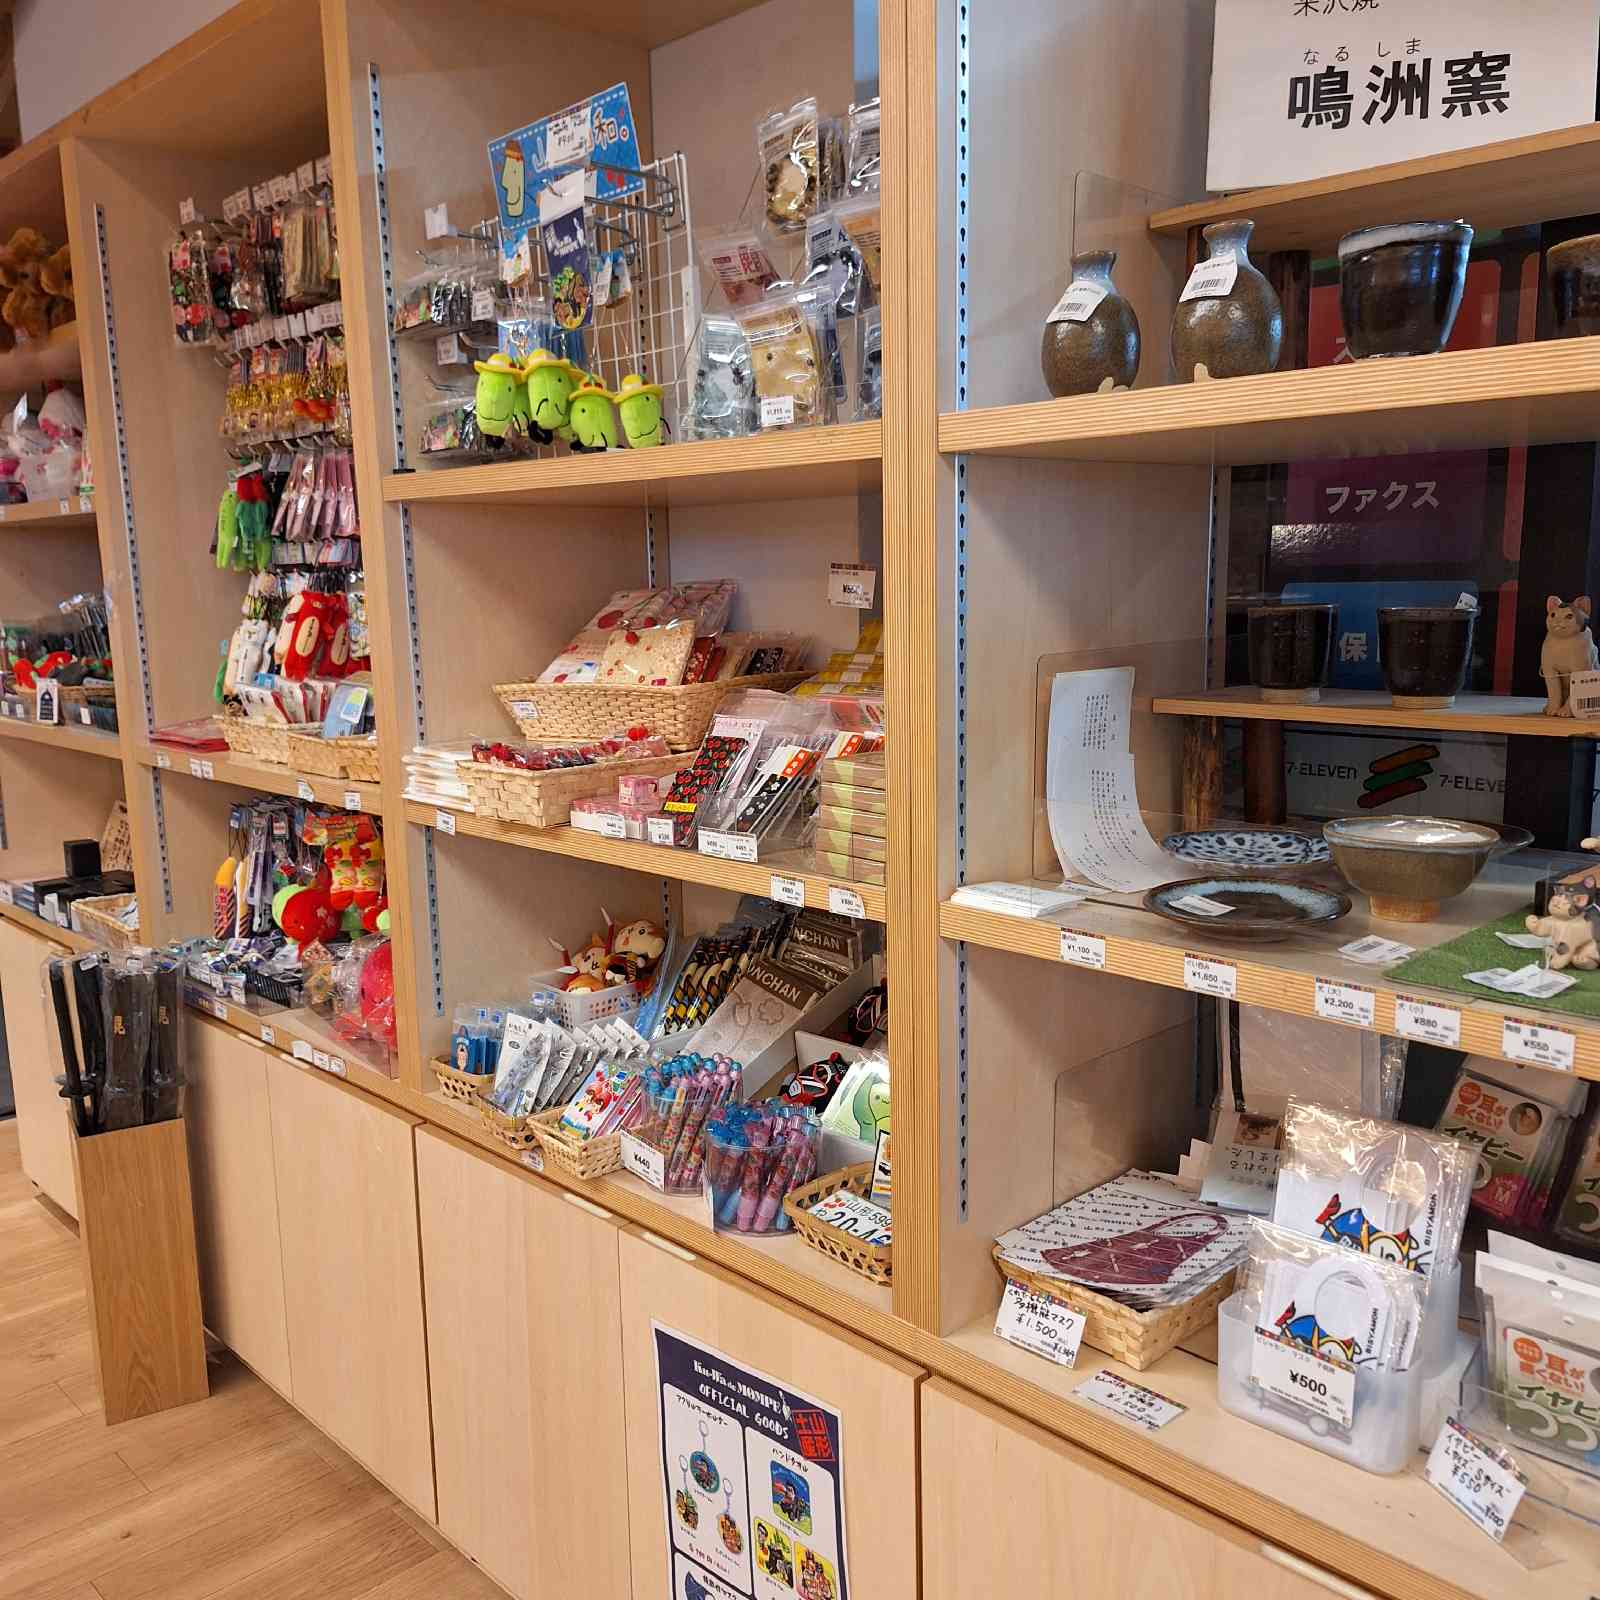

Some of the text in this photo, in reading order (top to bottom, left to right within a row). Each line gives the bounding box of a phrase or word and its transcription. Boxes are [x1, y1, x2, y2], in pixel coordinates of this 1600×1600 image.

[1303, 37, 1422, 65] なるしま
[1286, 50, 1511, 130] 鳴洲窯
[1325, 480, 1440, 515] ファクス
[1324, 996, 1355, 1010] ¥2,200
[1414, 1016, 1438, 1029] ¥880
[1522, 1039, 1550, 1052] ¥550
[1013, 1297, 1075, 1331] 多機能マスク
[1366, 1307, 1379, 1355] BISYAMON
[1545, 1352, 1585, 1378] 耳が
[1288, 1369, 1328, 1397] ¥500
[699, 1382, 790, 1441] OFFICIAL GOODS
[1450, 1463, 1482, 1494] ¥550
